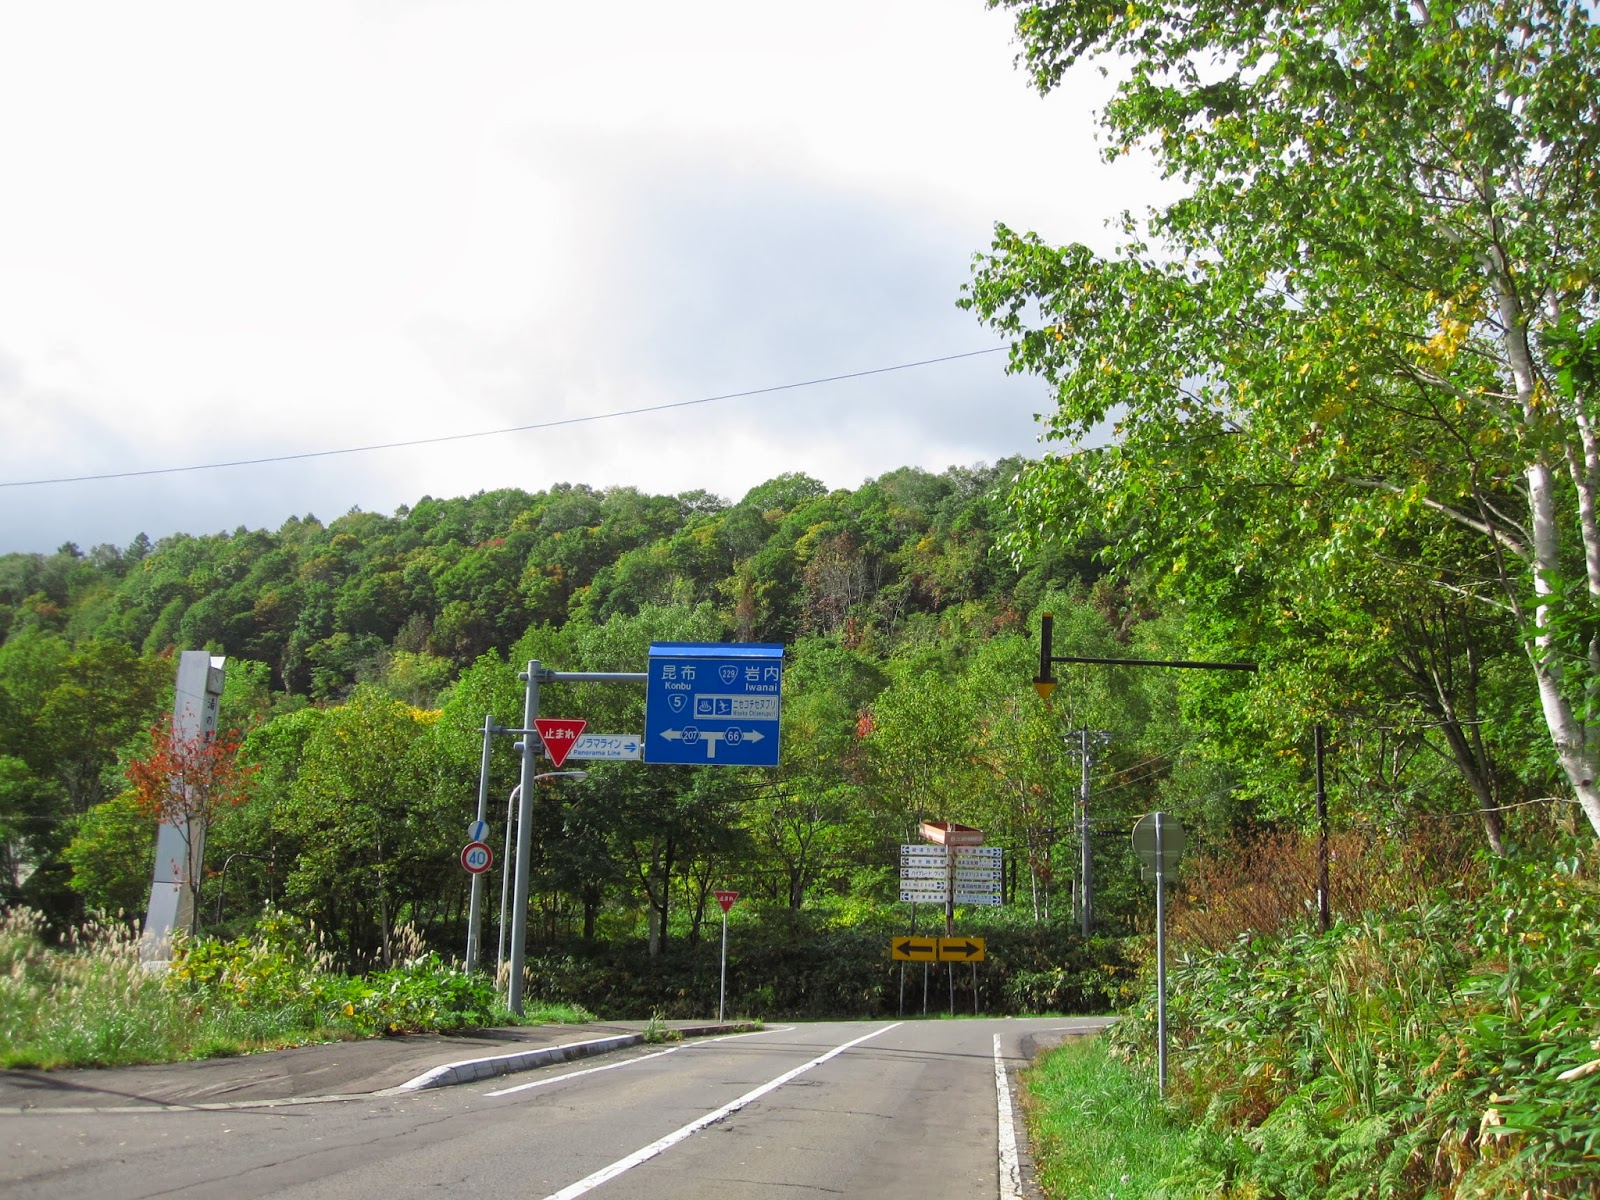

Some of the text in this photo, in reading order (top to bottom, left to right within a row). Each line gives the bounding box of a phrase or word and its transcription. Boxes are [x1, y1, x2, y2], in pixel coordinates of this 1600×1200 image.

[661, 664, 697, 681] 昆布
[722, 669, 735, 678] 229
[744, 665, 779, 682] 岩内
[665, 681, 692, 690] Konbu
[745, 682, 778, 692] Iwanai
[673, 696, 681, 708] 5
[544, 727, 575, 739] 止まれ
[683, 731, 698, 740] 207
[727, 731, 739, 741] 66
[468, 851, 486, 865] 40
